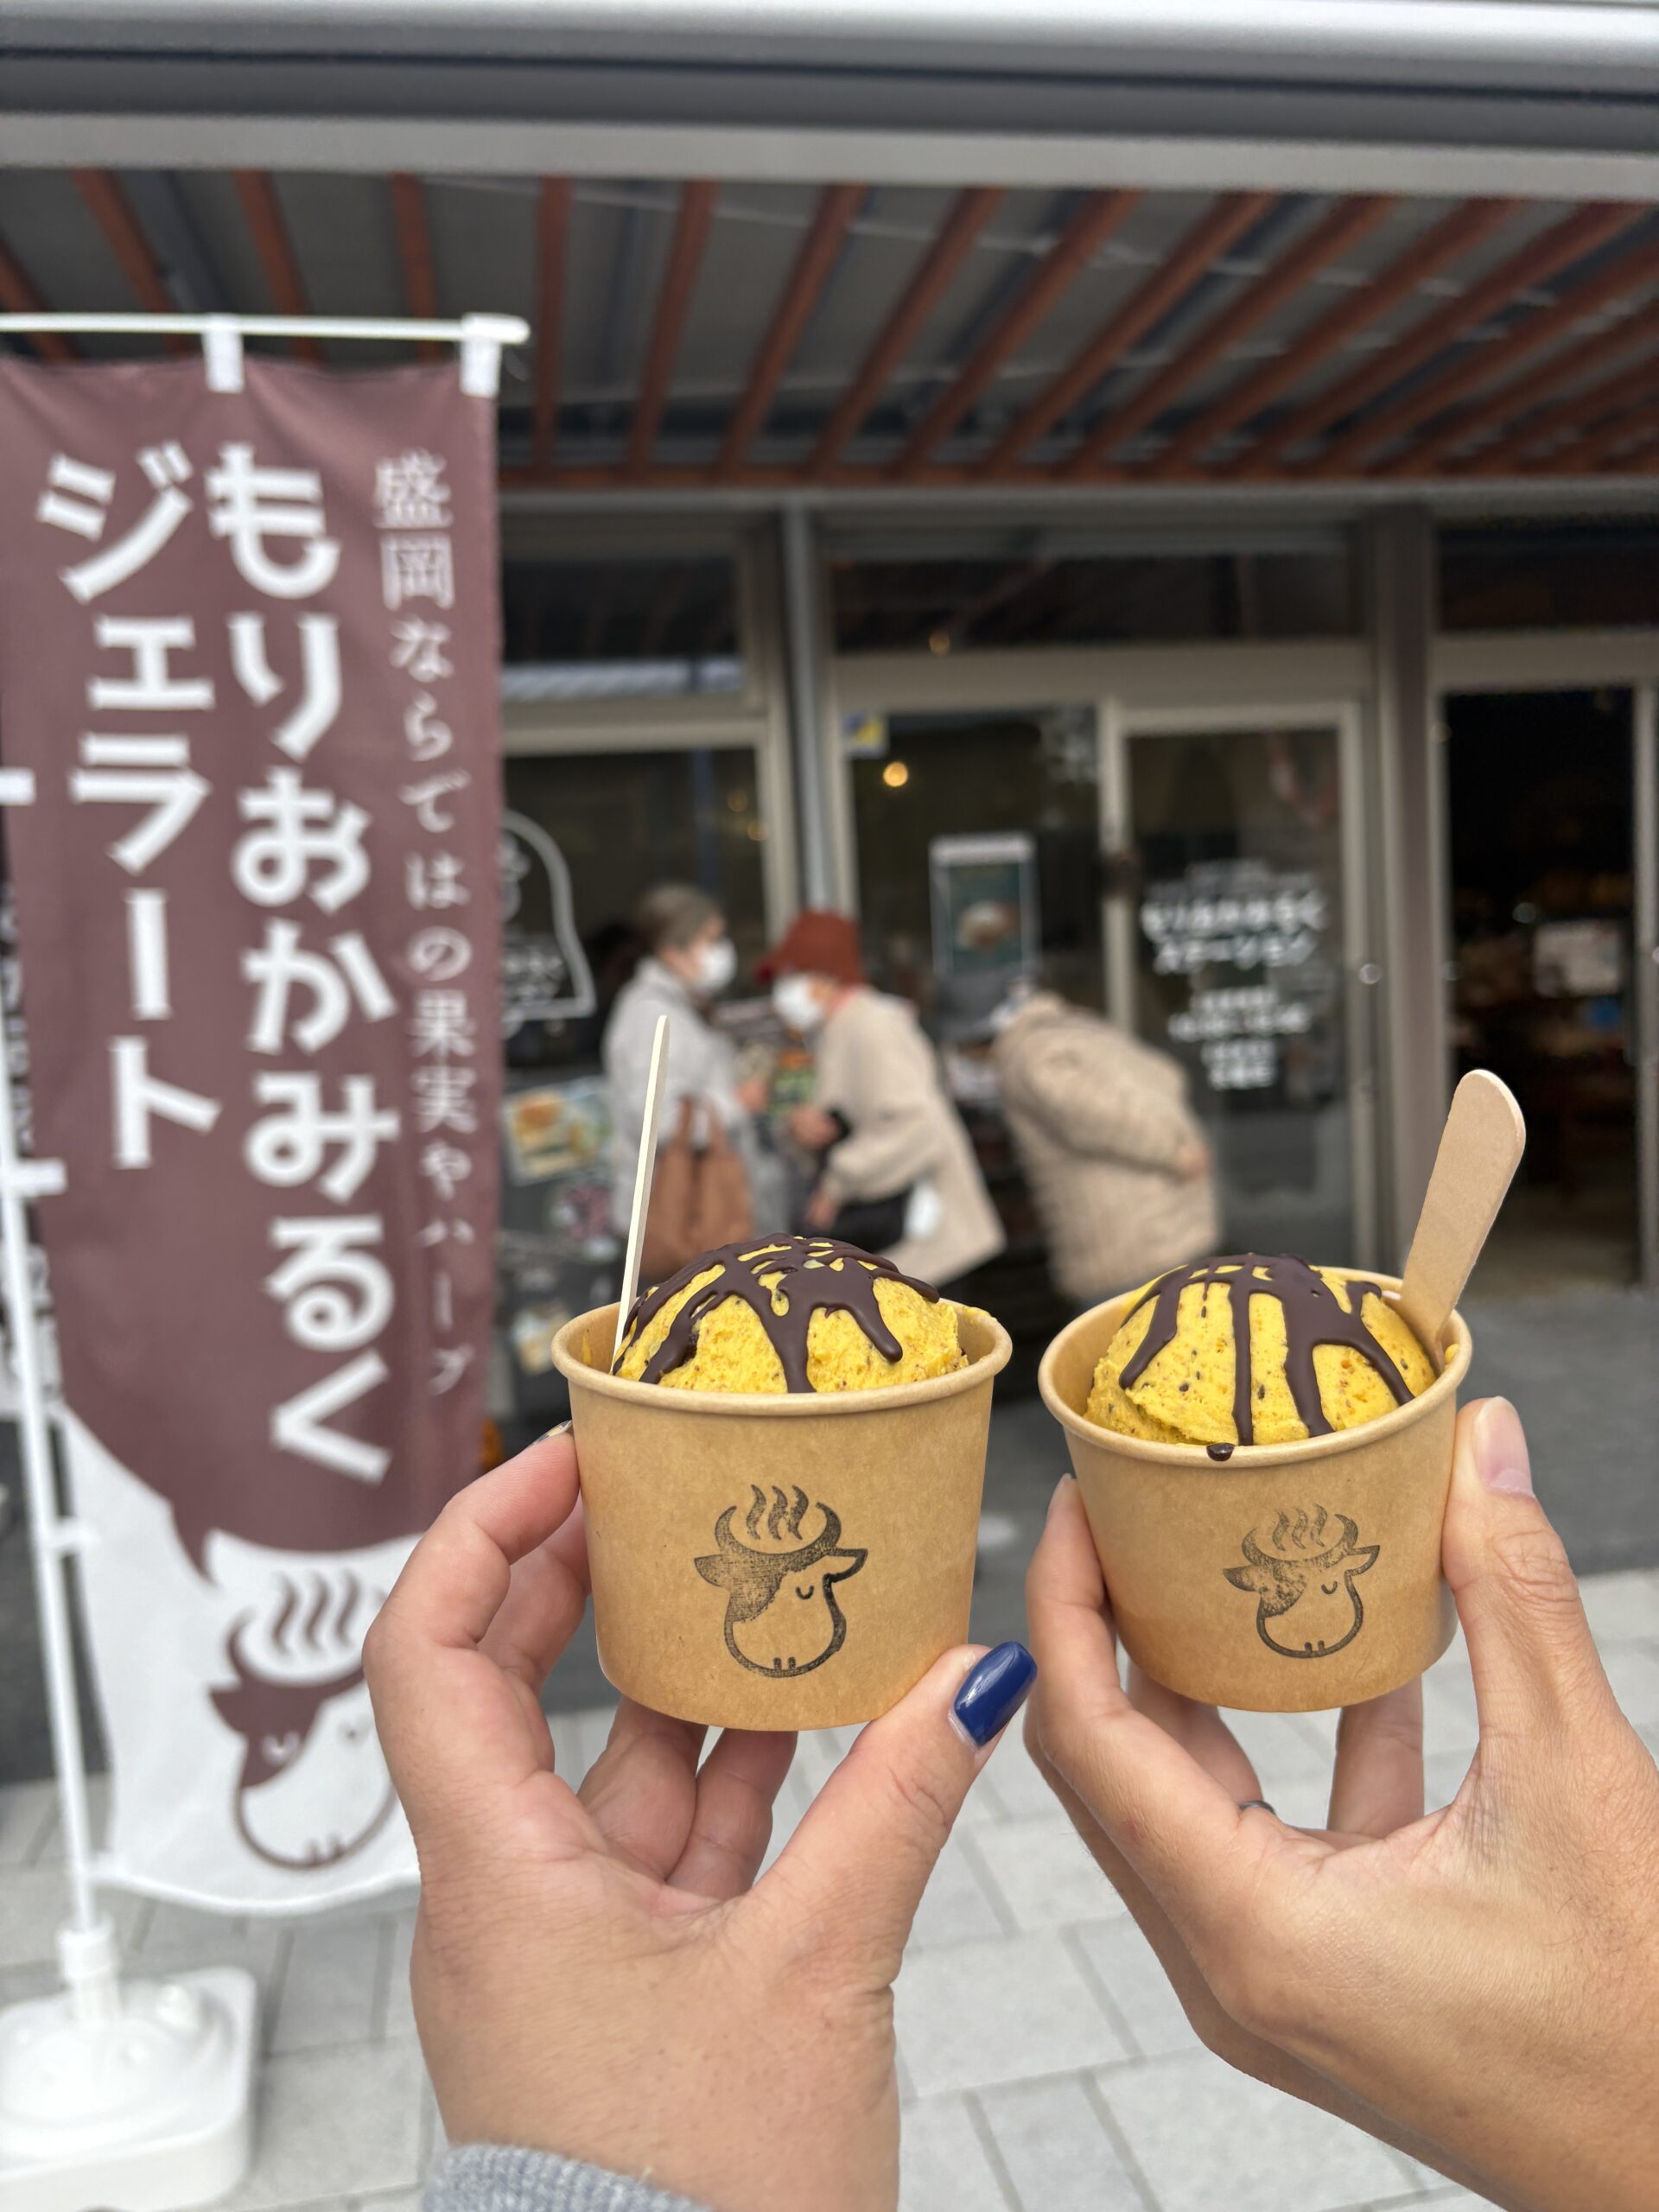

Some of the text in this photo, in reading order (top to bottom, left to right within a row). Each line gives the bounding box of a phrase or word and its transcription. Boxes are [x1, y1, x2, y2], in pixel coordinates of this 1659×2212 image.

[37, 442, 221, 1169] ジェラート
[205, 442, 401, 1484] もりおかみるく
